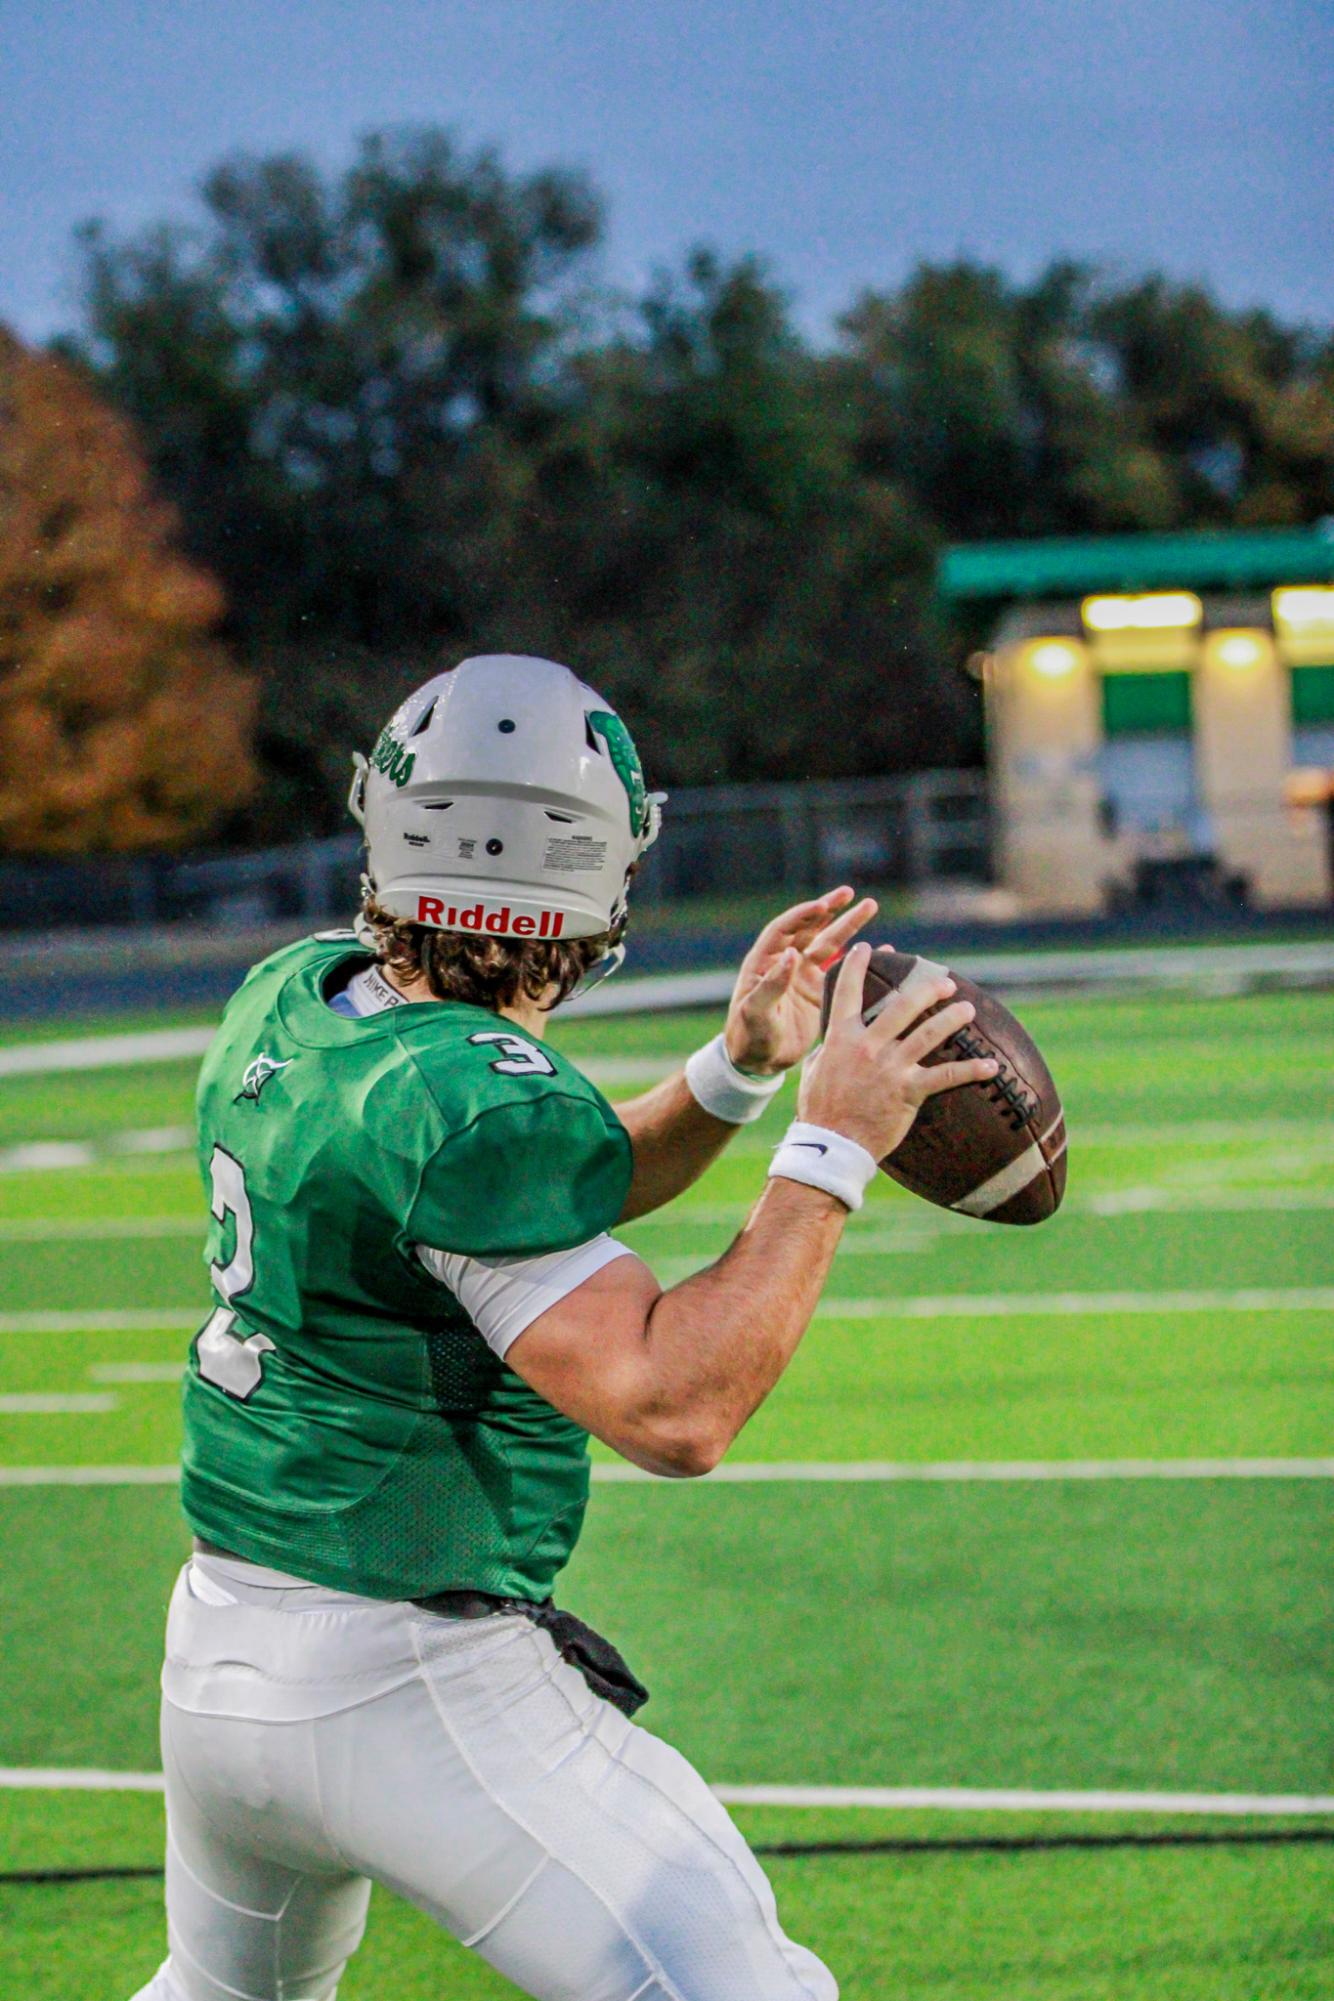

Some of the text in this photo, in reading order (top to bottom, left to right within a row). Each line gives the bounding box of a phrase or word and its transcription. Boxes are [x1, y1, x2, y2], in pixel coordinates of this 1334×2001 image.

[417, 896, 564, 937] Riddell
[363, 973, 389, 1002] NIKE
[465, 1031, 558, 1077] 3
